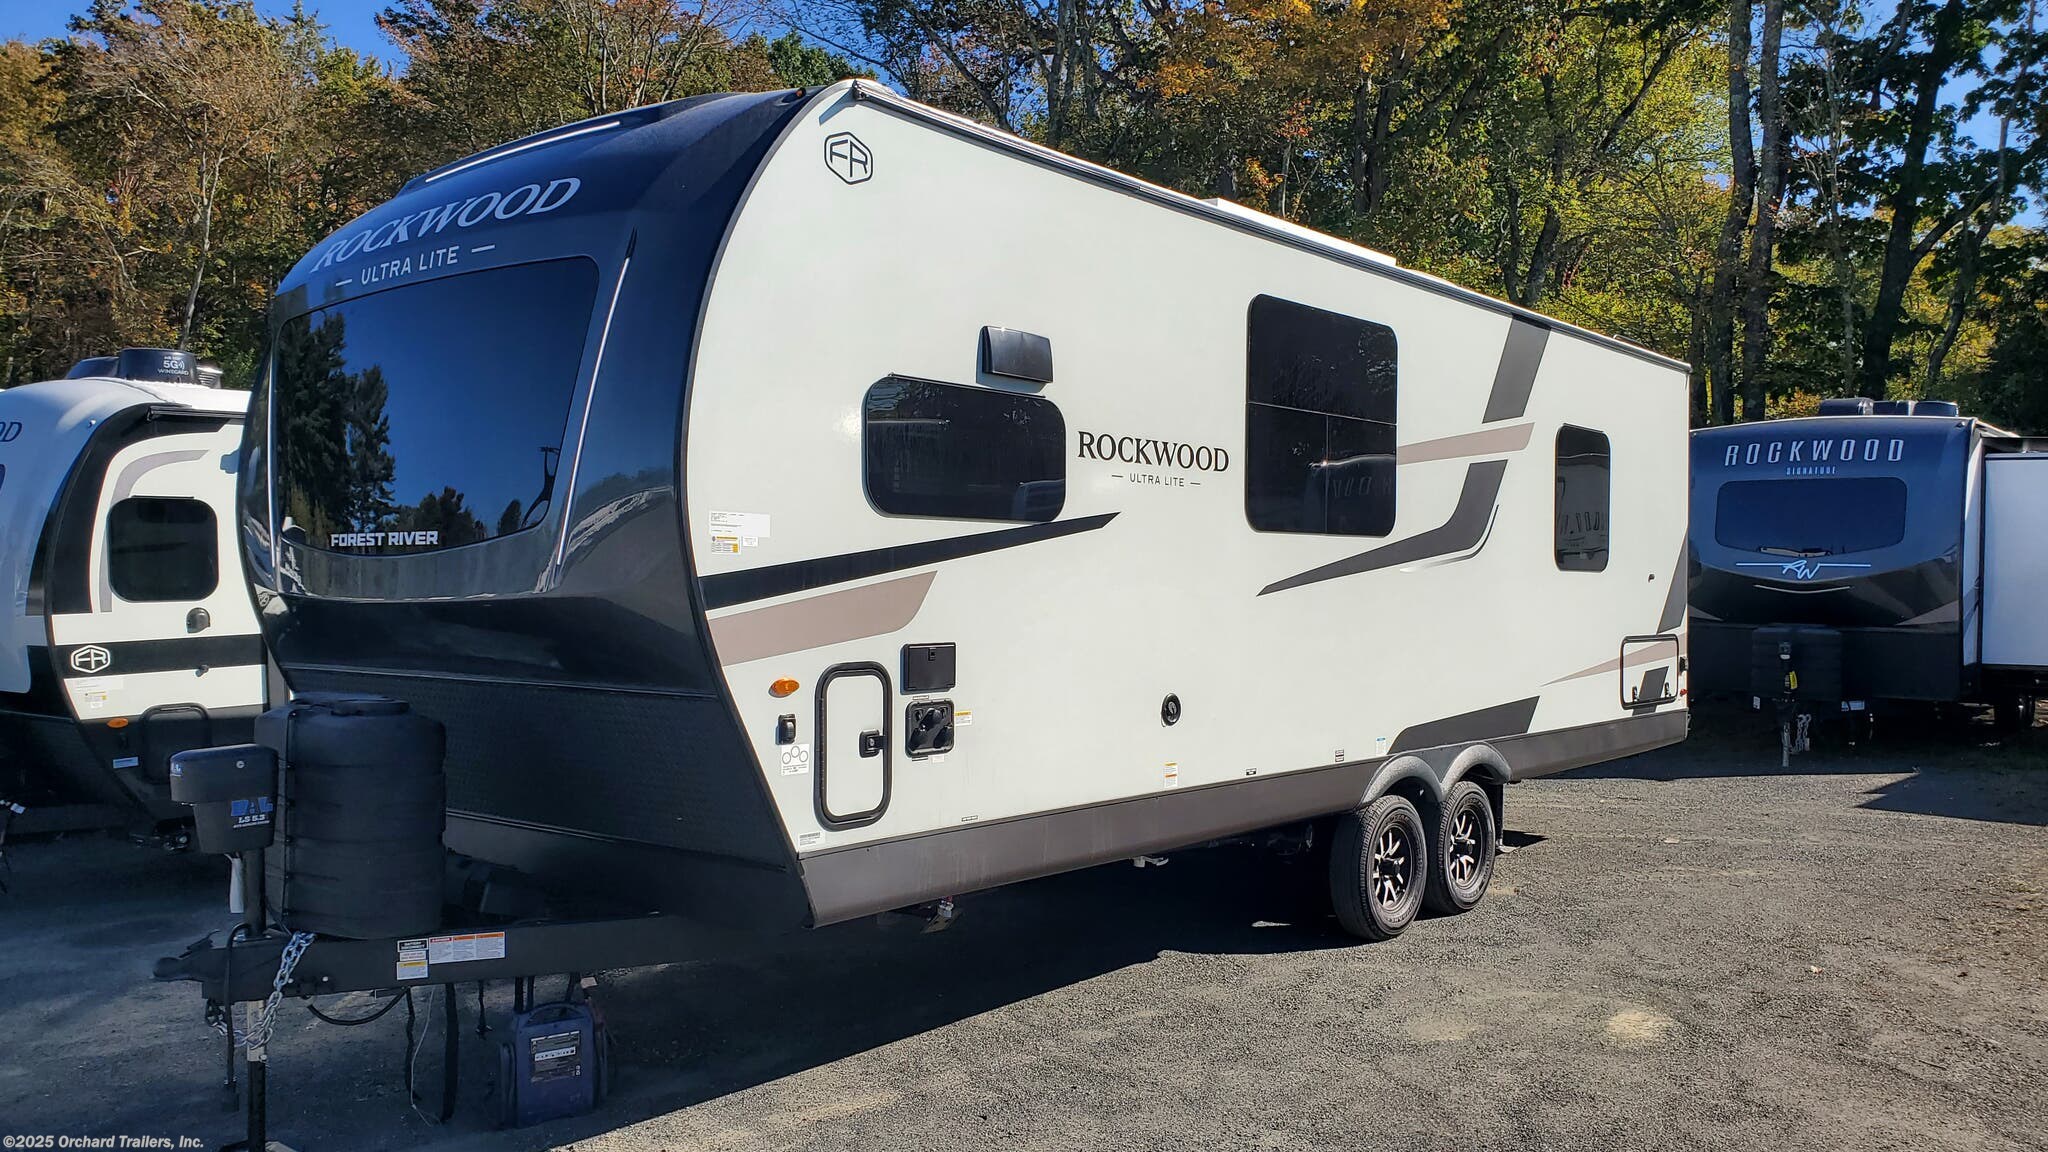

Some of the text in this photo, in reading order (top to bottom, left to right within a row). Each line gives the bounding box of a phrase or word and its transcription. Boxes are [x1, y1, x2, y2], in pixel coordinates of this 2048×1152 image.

[310, 177, 581, 273] ROCKWOOD
[361, 245, 461, 285] ULTRA LITE
[163, 360, 179, 369] 5G
[1077, 430, 1230, 472] ROCKWOOD
[1724, 439, 1904, 466] ROCKWOOD
[1129, 472, 1185, 487] ULTRA LITE
[330, 530, 439, 547] FOREST RIVER
[238, 816, 251, 824] LS
